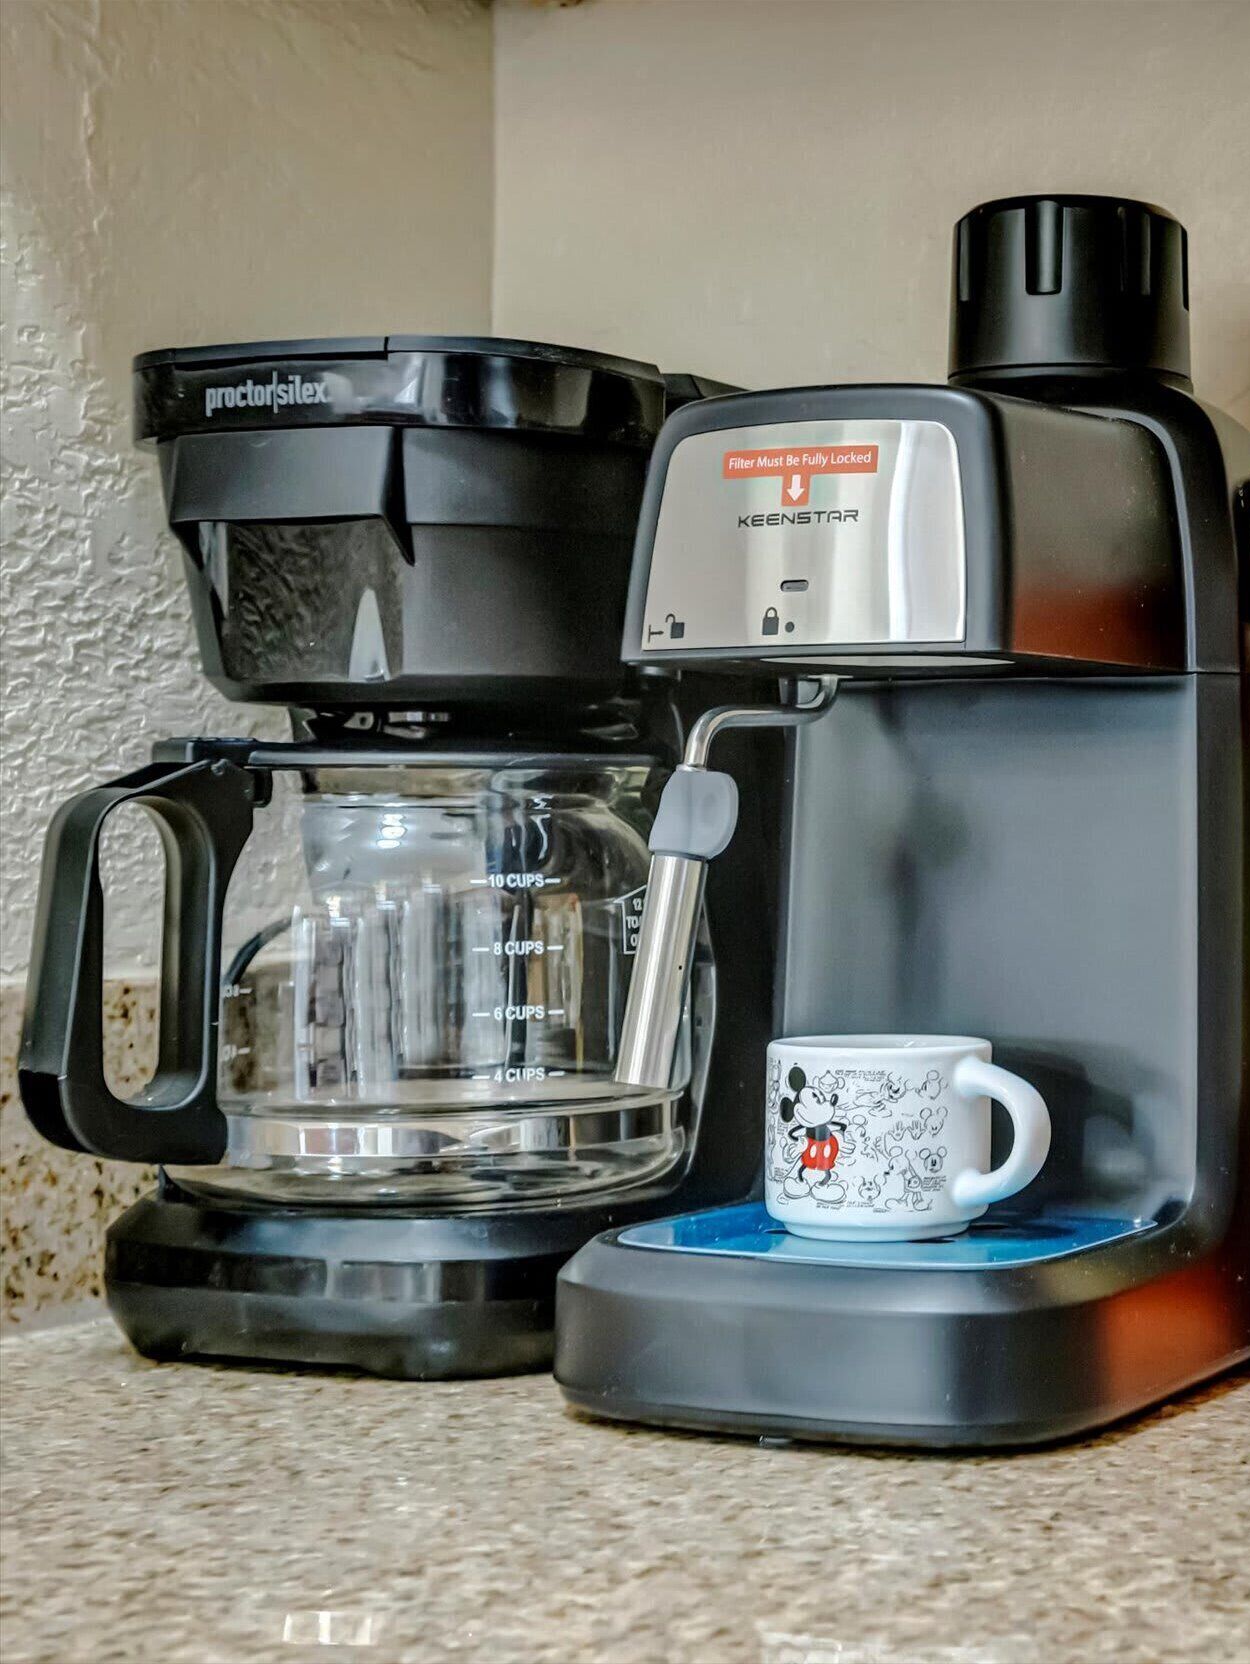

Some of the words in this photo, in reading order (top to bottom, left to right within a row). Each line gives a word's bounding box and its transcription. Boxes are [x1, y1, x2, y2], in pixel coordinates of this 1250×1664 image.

[728, 456, 755, 470] Filter
[757, 456, 783, 468] Must
[786, 454, 800, 467] Be
[802, 454, 827, 469] Fully
[830, 452, 872, 465] Locked
[738, 509, 859, 528] KEENSTAR
[489, 874, 504, 888] 10
[507, 873, 545, 888] CUPS
[493, 942, 502, 955] 8
[505, 940, 544, 955] CUPS
[494, 1008, 502, 1021] 6
[506, 1006, 545, 1020] CUPS
[494, 1070, 503, 1083] 4
[506, 1067, 545, 1082] CUPS
